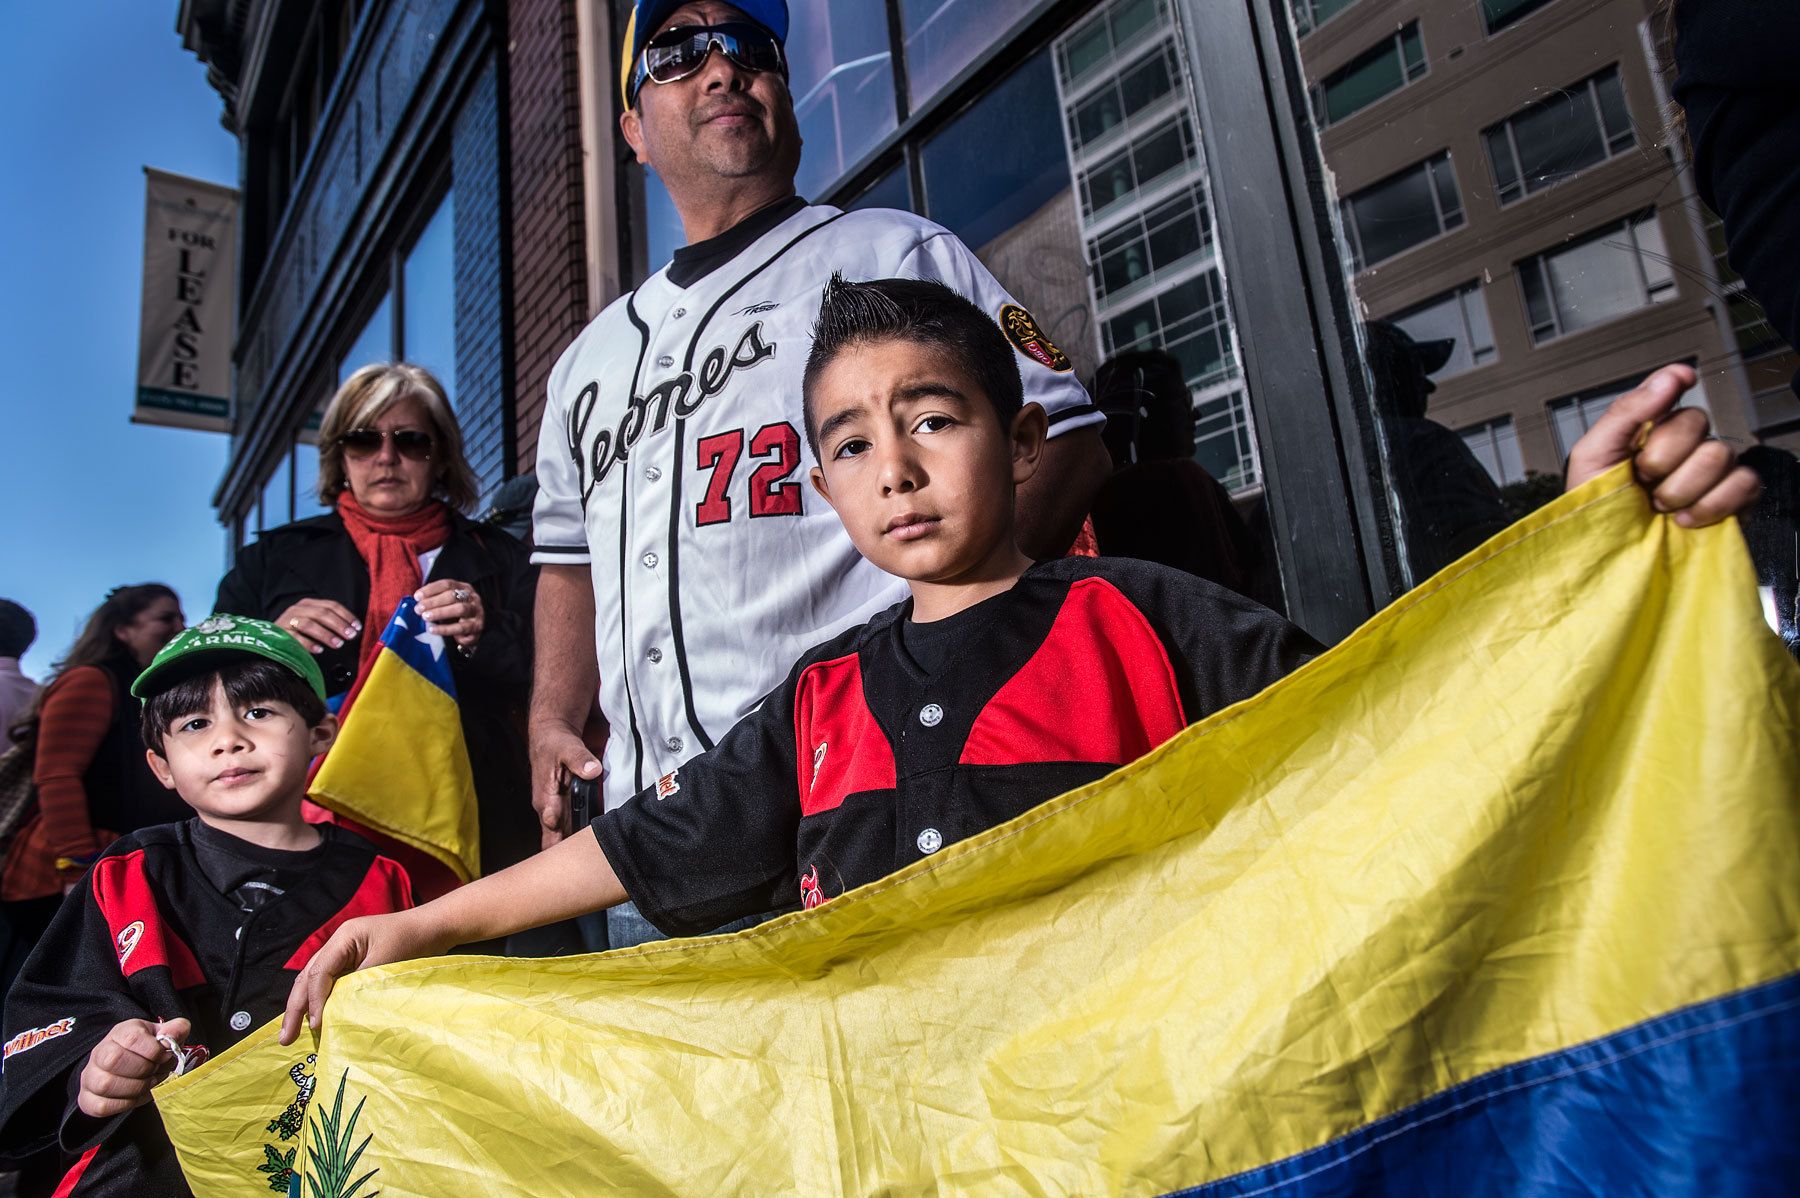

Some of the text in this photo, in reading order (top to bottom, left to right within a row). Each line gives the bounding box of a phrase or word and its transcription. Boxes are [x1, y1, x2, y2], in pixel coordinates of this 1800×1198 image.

[167, 228, 217, 250] FOR
[172, 248, 206, 390] LEASE
[567, 320, 777, 500] Leones
[696, 420, 804, 528] 72
